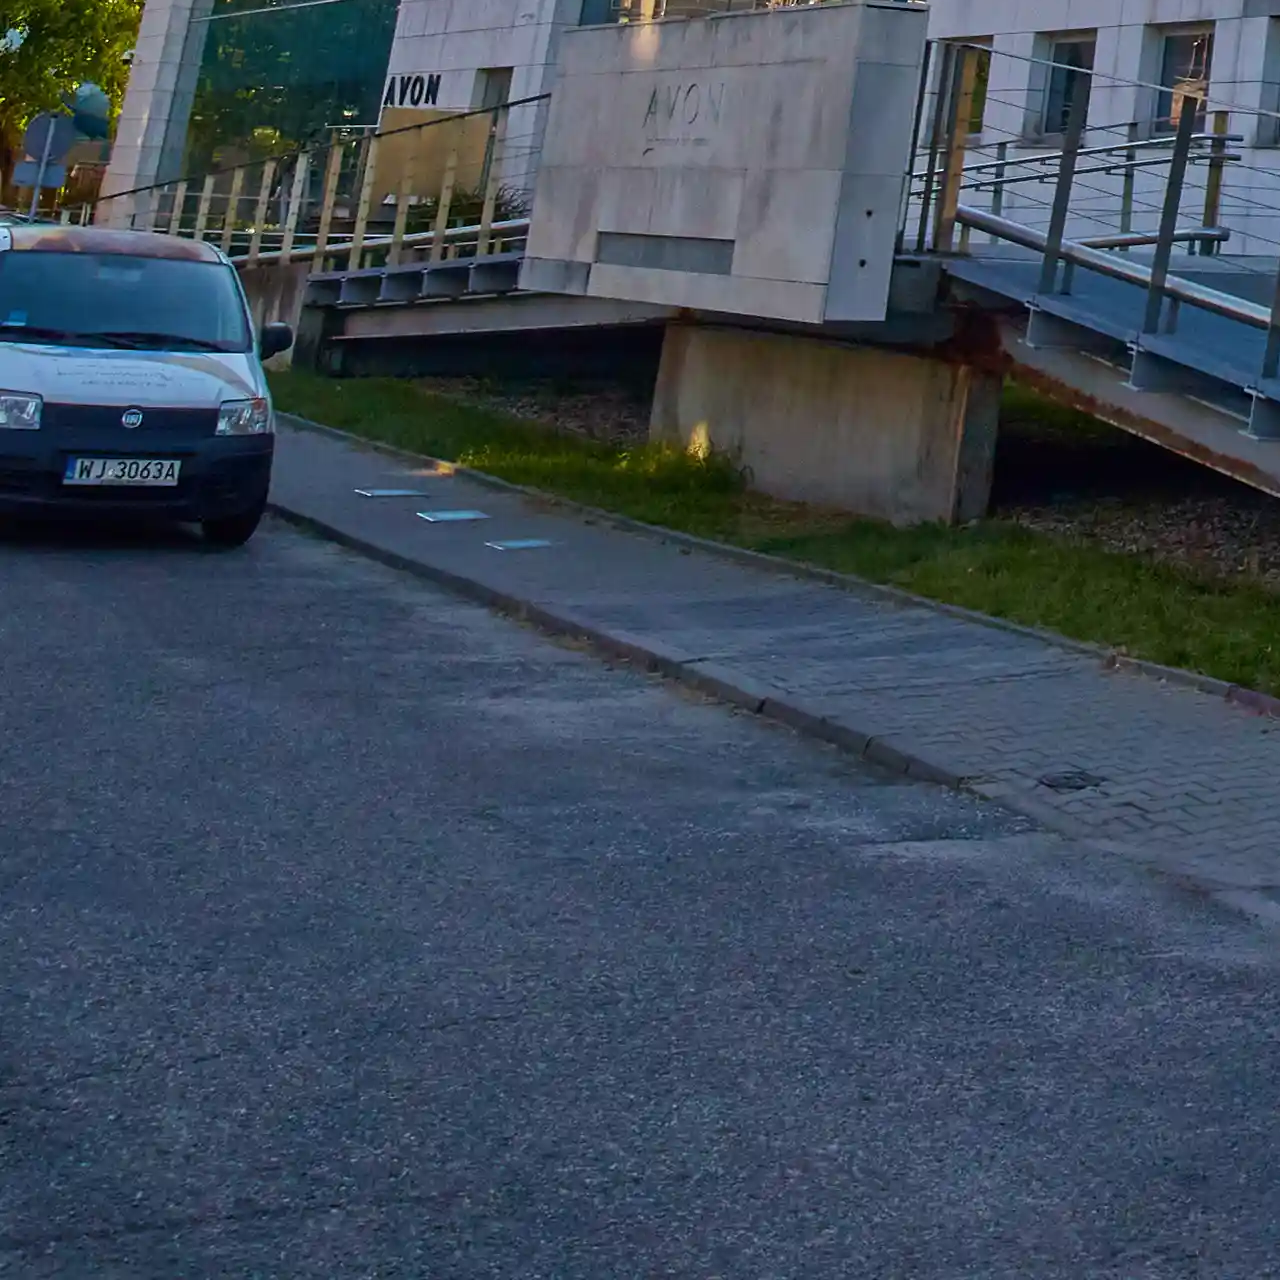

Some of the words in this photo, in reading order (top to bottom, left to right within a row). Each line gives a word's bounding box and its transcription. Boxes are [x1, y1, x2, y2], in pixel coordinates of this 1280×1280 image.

[383, 73, 442, 107] AVON
[642, 82, 725, 128] AVON
[78, 460, 107, 479] WJ
[114, 460, 177, 480] 3063A
